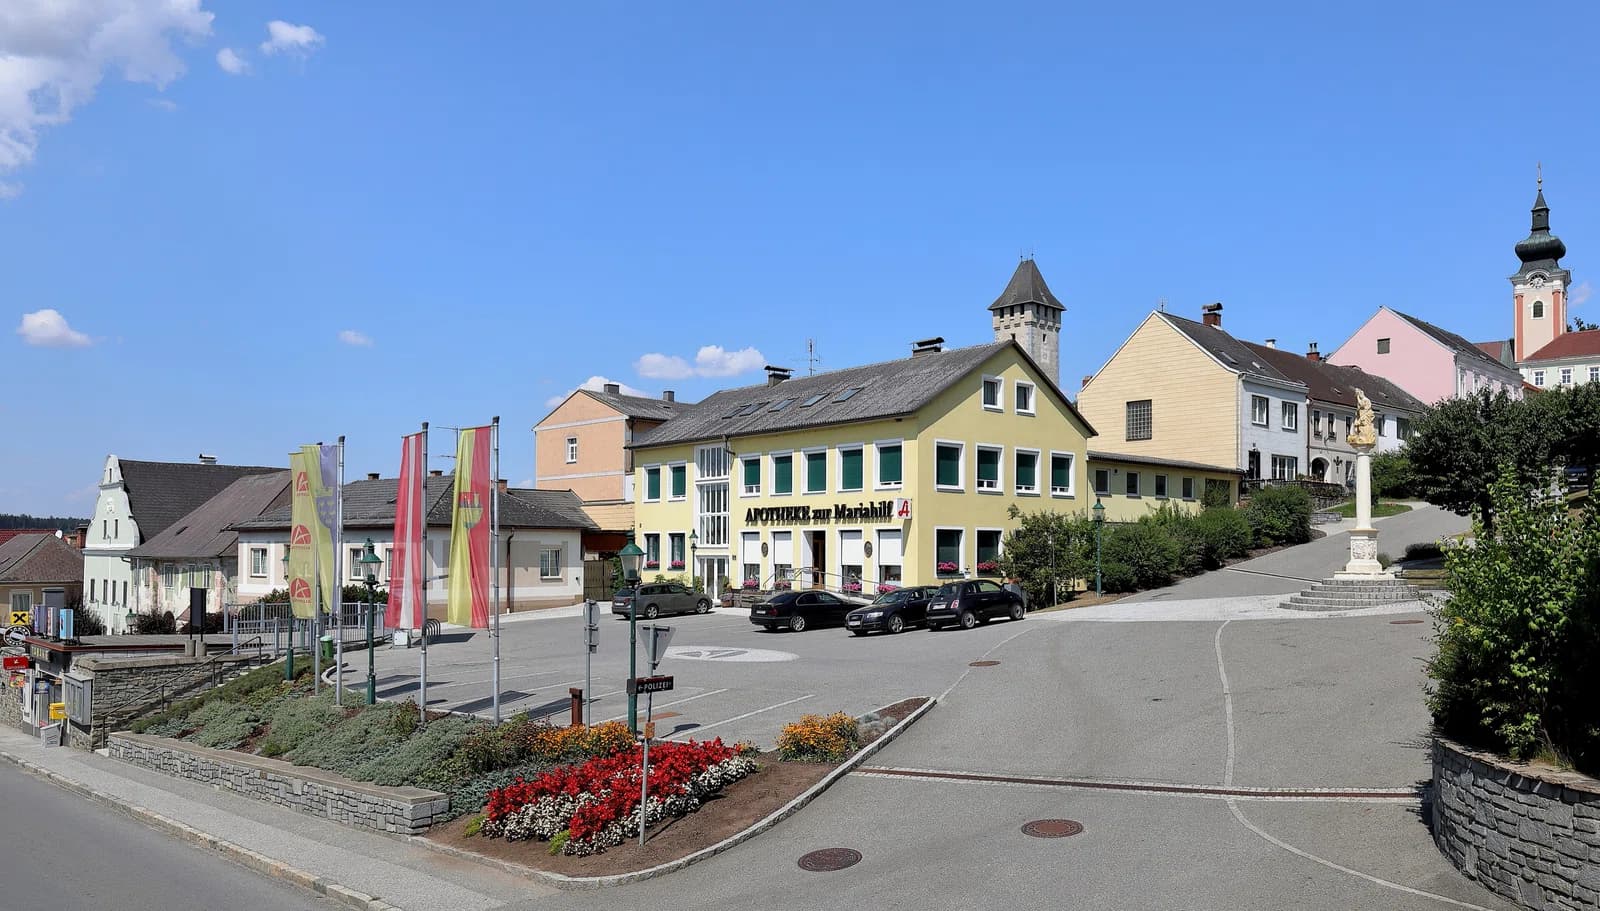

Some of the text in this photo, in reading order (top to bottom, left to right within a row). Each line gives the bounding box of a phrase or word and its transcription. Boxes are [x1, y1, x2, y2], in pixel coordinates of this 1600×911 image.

[745, 501, 894, 522] APOTHEKE zur Mariahilf
[644, 681, 669, 690] POLIZEI
